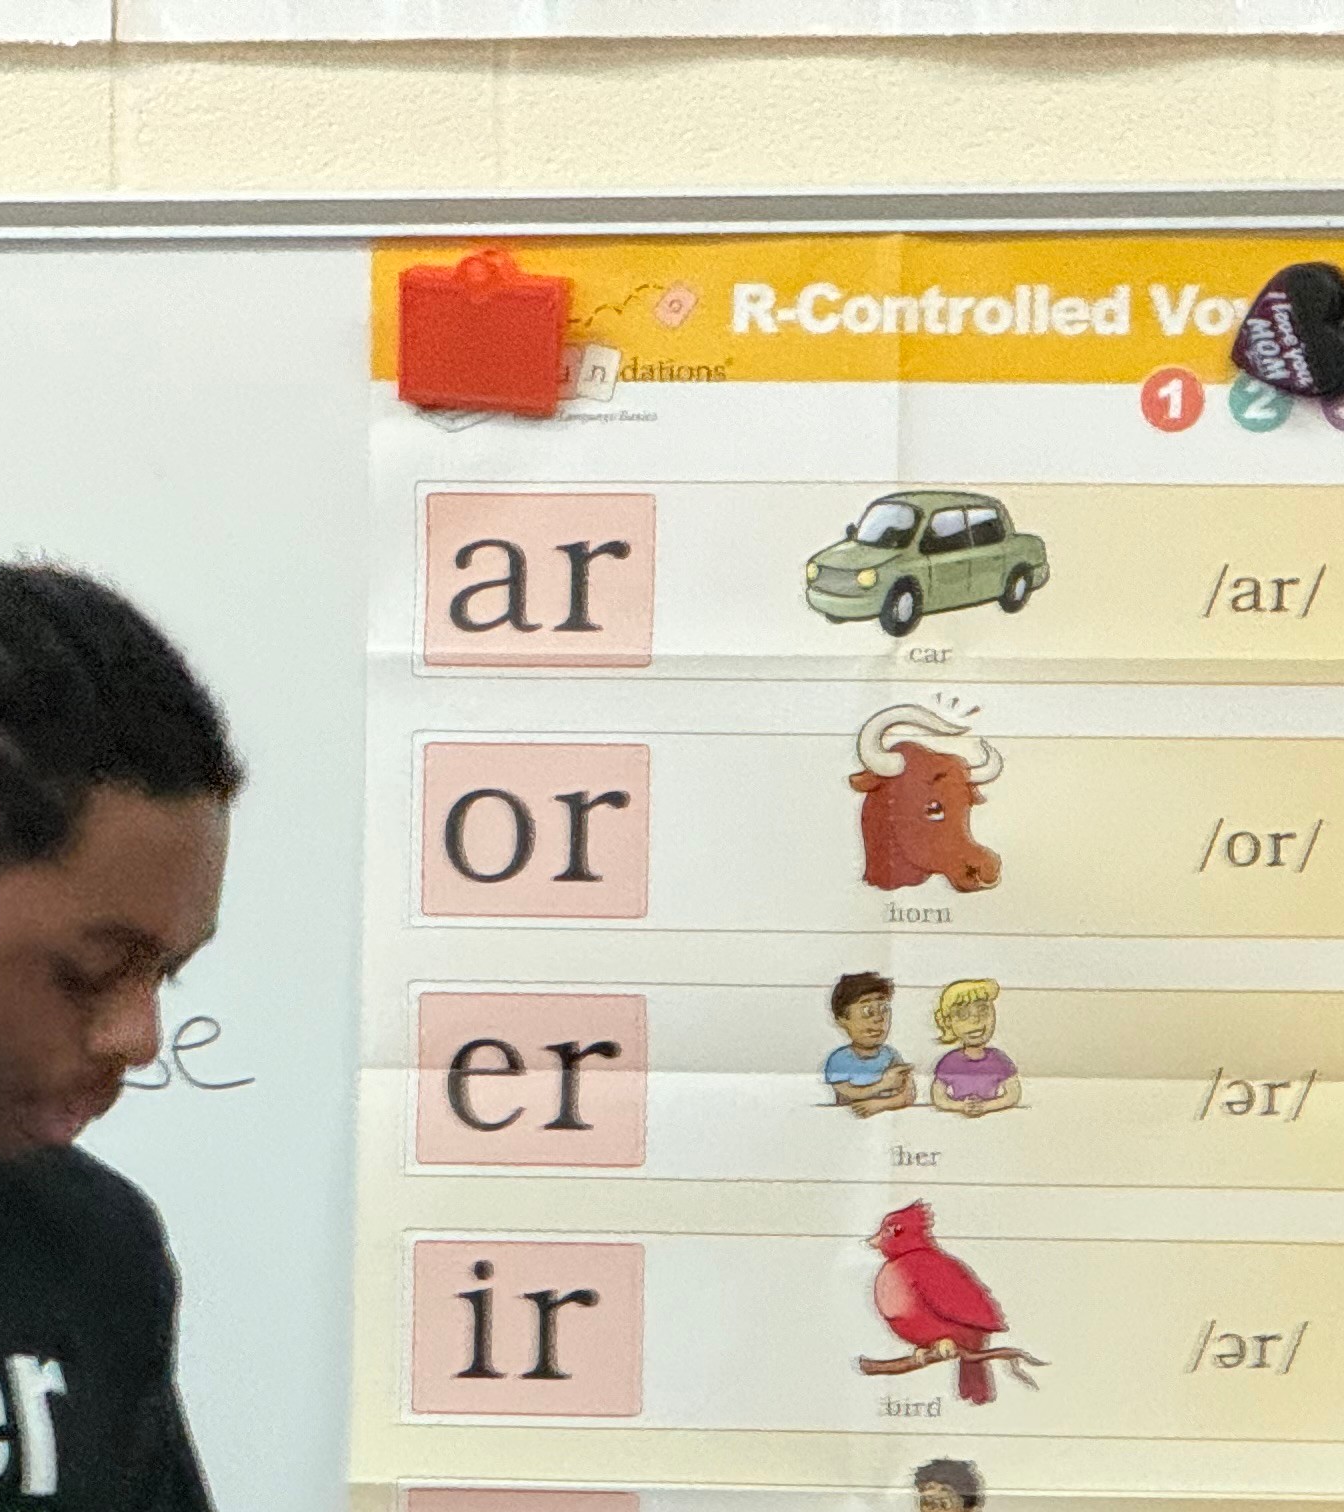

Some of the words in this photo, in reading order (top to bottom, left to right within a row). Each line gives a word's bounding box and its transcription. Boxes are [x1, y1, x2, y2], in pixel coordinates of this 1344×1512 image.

[733, 282, 1131, 334] R-Controlled
[1246, 319, 1292, 379] MOM
[1159, 379, 1183, 419] 1
[449, 536, 630, 634] ar
[1203, 562, 1328, 620] /ar/
[909, 647, 953, 663] car
[443, 787, 627, 885] or
[1199, 817, 1324, 874] /or/
[447, 1030, 621, 1132] er
[454, 1260, 600, 1381] ir
